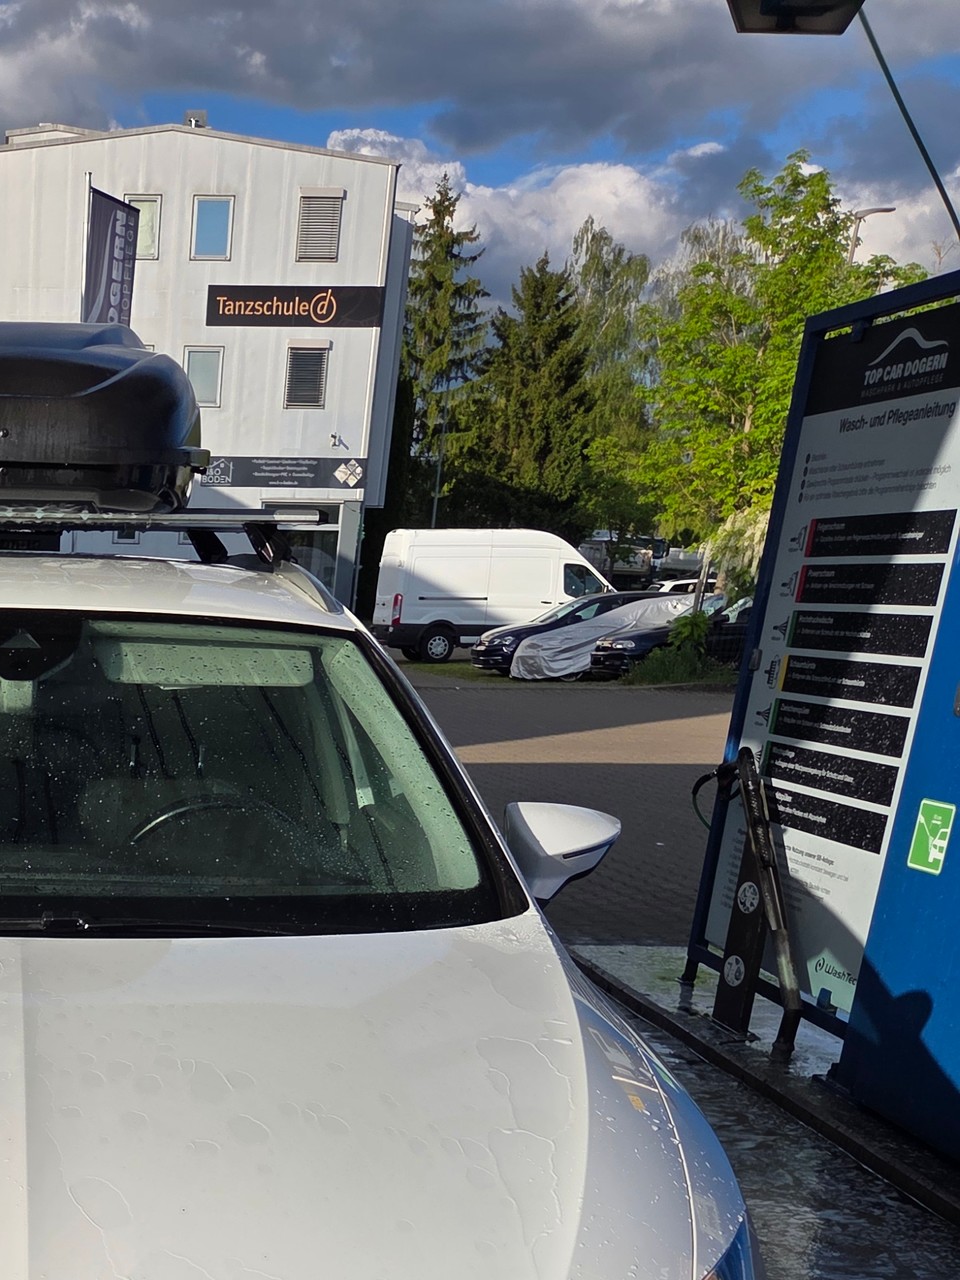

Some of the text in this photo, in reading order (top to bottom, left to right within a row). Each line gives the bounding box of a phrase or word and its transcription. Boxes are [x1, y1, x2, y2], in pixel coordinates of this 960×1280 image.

[108, 209, 126, 324] OGERN
[121, 216, 135, 322] TOPFLEGE
[216, 296, 308, 316] Tanzschule
[864, 352, 949, 386] TOP CAR DOGERN
[839, 402, 956, 433] Wasch- und Pflegeanleitung
[824, 963, 857, 986] WashTec
